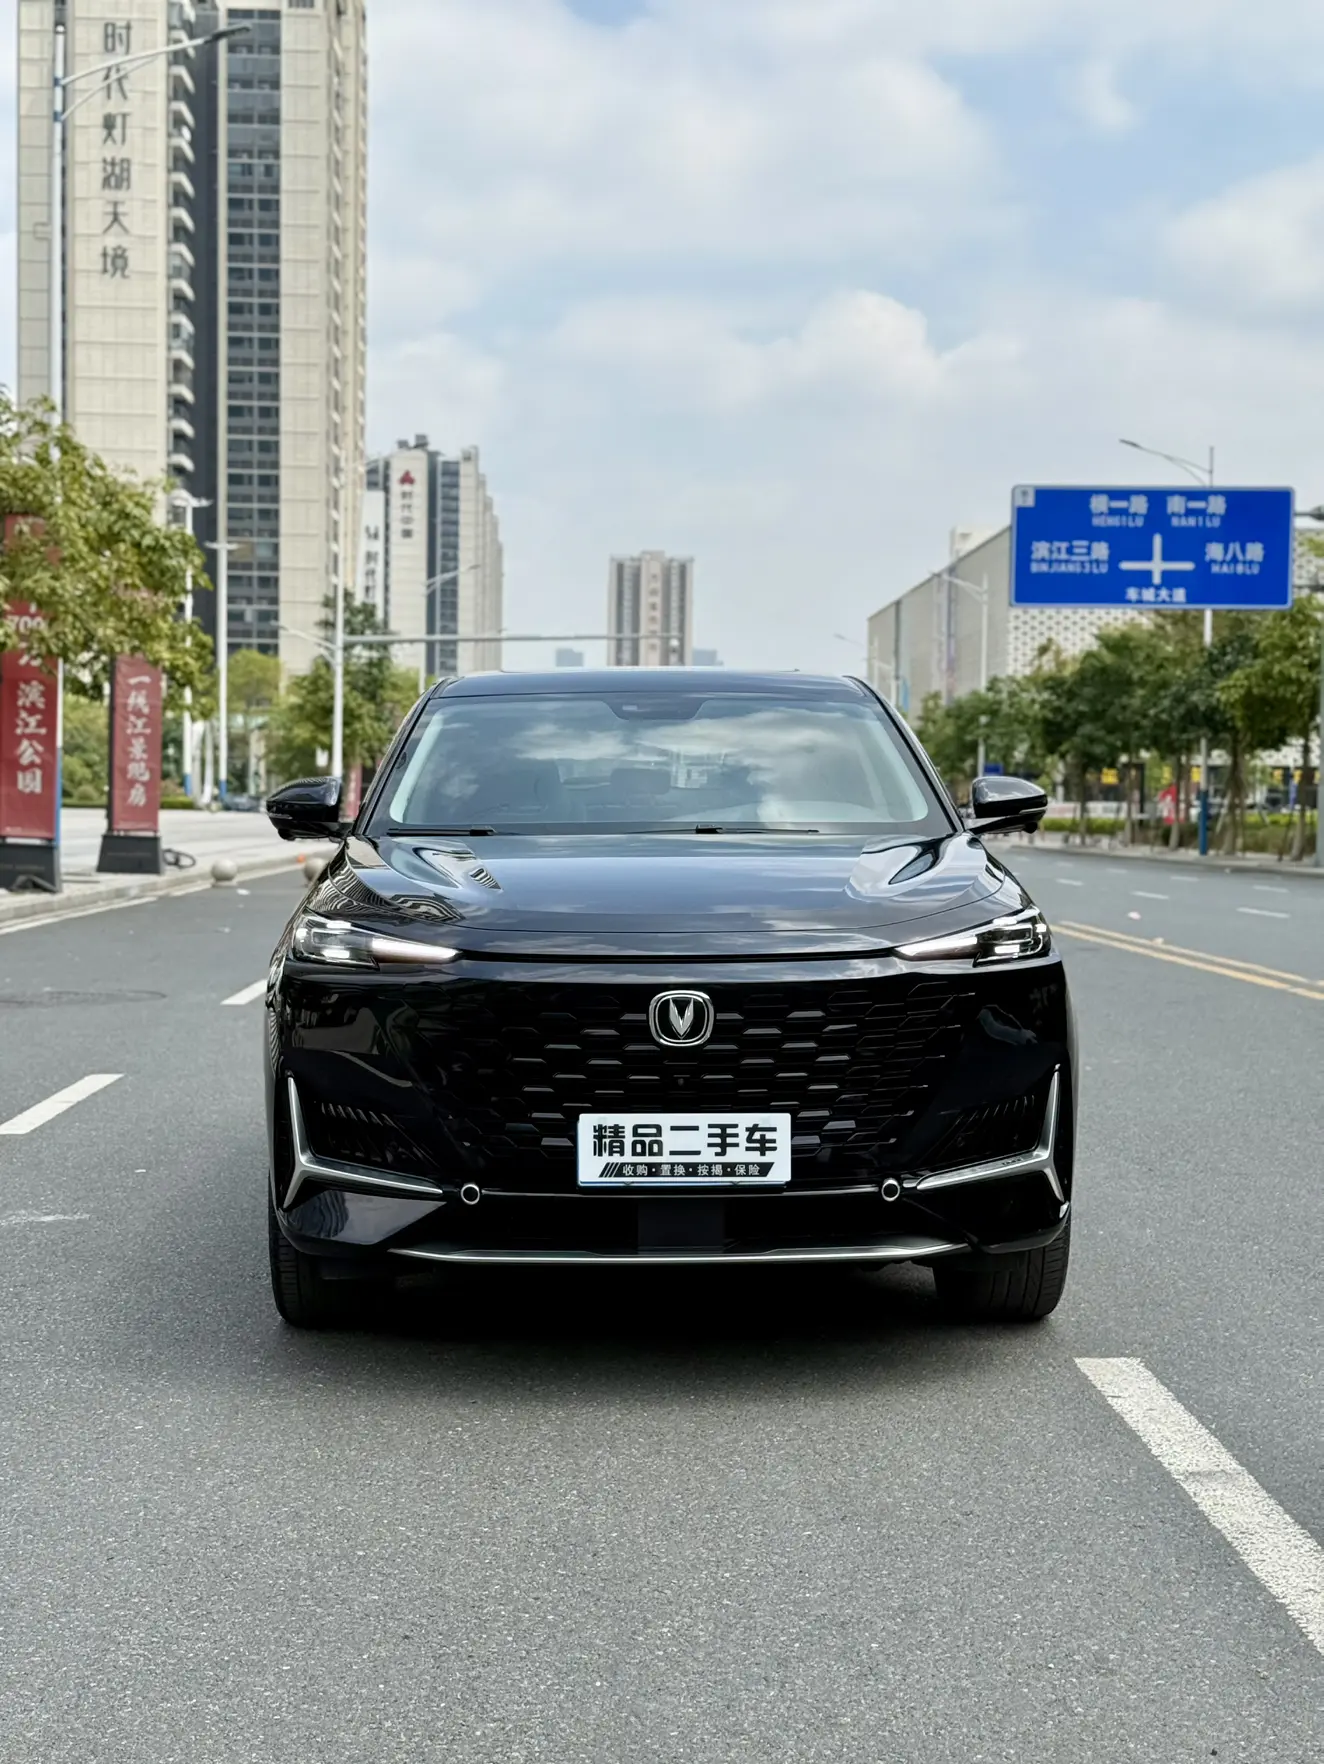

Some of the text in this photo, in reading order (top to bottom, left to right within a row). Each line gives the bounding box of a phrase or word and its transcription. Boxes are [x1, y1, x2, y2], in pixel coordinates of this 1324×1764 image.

[592, 1123, 778, 1157] 精品二手车
